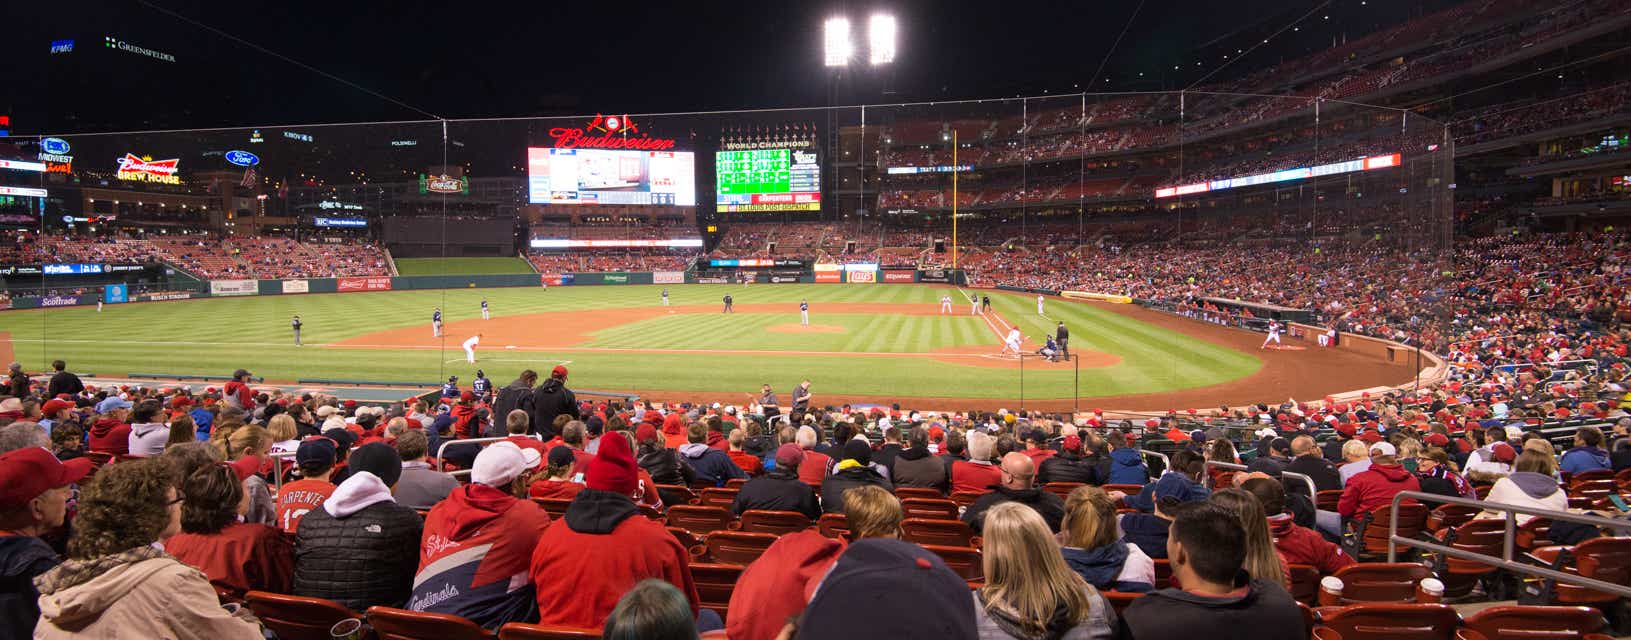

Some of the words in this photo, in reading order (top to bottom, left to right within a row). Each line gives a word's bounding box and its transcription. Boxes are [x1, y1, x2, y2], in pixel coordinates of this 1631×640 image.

[117, 41, 176, 62] GREENSFELDER
[549, 127, 676, 150] Budweiser
[727, 142, 758, 150] WORLD
[759, 140, 810, 149] CHAMPIONS
[38, 152, 73, 163] MIDWEST
[117, 157, 179, 174] Budweiser
[118, 171, 145, 182] BREW
[147, 173, 180, 185] HOUSE
[411, 583, 460, 613] Cardinals
